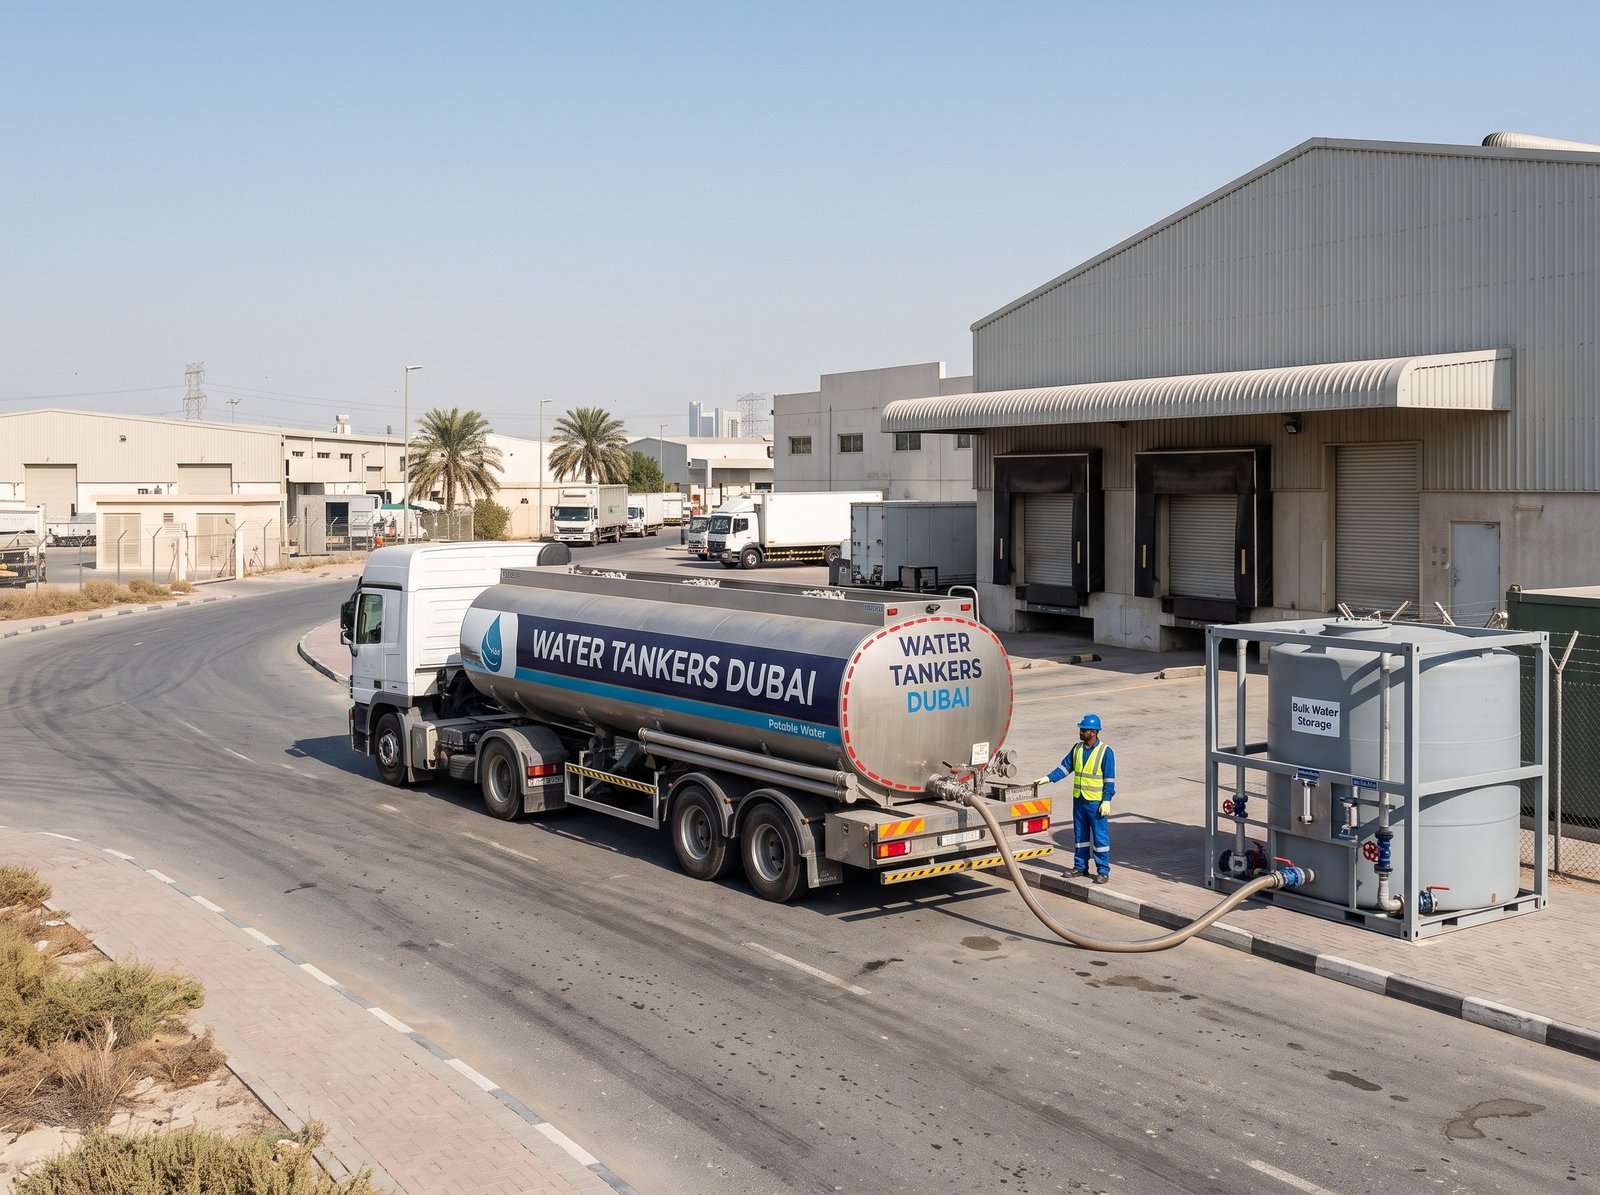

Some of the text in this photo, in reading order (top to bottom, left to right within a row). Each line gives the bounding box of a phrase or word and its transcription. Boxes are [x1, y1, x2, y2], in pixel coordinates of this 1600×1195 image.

[899, 632, 971, 657] WATER
[533, 629, 816, 705] WATER TANKERS DUBAI
[889, 658, 982, 686] TANKERS
[907, 687, 970, 712] DUBAI
[1292, 702, 1339, 717] Bulk Water
[768, 718, 826, 738] Potable Water
[1297, 716, 1332, 731] Storage
